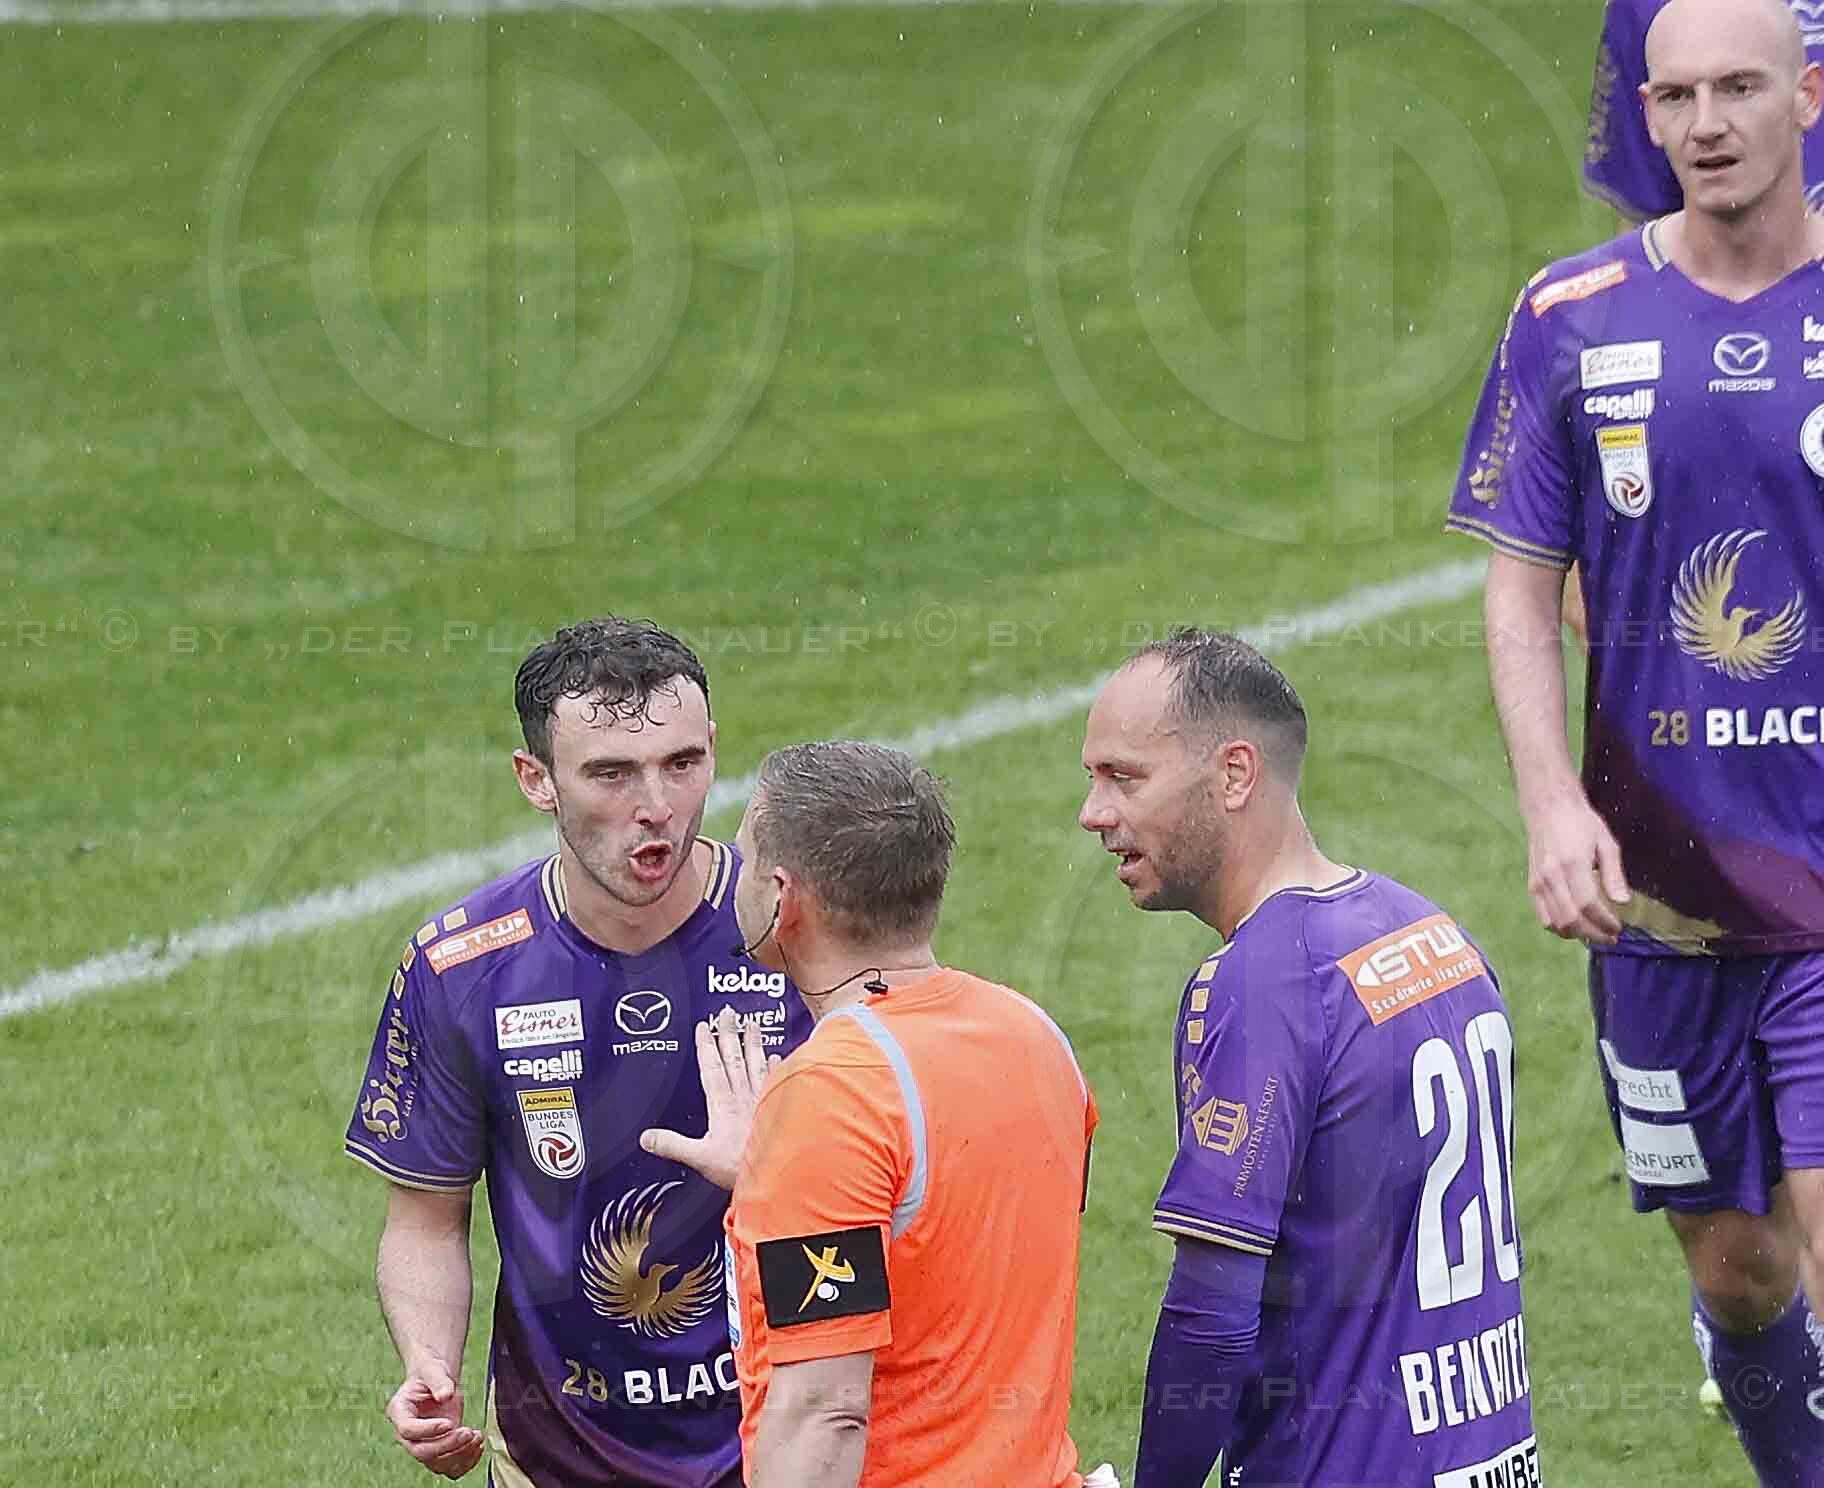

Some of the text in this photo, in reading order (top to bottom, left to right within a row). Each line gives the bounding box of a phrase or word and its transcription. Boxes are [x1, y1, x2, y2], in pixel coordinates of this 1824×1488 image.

[1583, 388, 1656, 419] capelli
[1648, 711, 1690, 747] 28
[707, 965, 786, 998] kelag
[501, 1009, 578, 1037] Eisner
[522, 1008, 557, 1021] AUTO
[612, 1038, 679, 1056] mazda
[503, 1050, 583, 1081] capelli
[540, 1070, 583, 1083] SPORT
[523, 1092, 571, 1107] ADMIRAL
[526, 1109, 575, 1124] BUNDES
[538, 1119, 566, 1131] LIGA
[1411, 1011, 1521, 1311] 20
[561, 1351, 741, 1405] 28 BLAC
